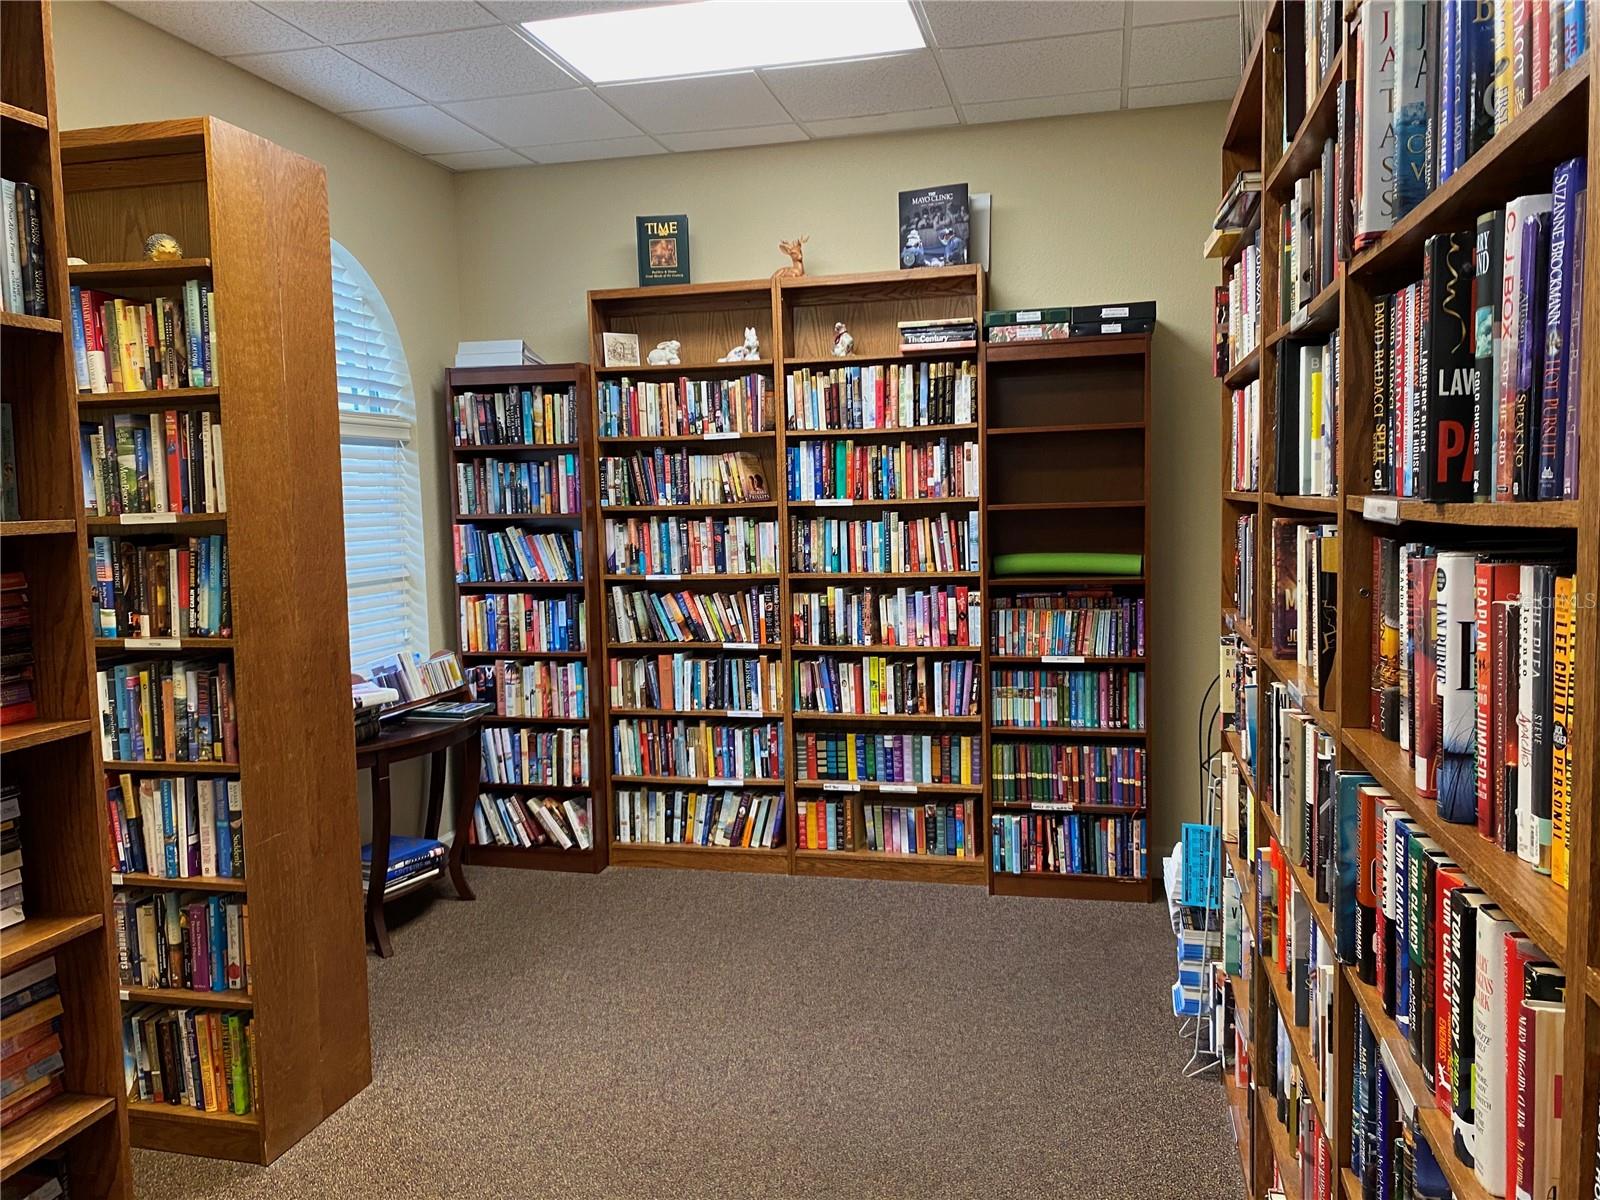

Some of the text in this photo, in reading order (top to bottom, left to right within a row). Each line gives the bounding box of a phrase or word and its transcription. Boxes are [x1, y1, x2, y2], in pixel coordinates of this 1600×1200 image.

[645, 222, 678, 235] TIME
[912, 195, 930, 205] MAYO
[930, 193, 954, 203] CLINIC
[1548, 174, 1569, 326] SUZANNE BROCKMANN
[82, 294, 92, 323] PRIMARY
[84, 324, 94, 351] COLORS
[1503, 276, 1515, 342] BOX
[1374, 302, 1387, 465] DAVID BALDACCI SPLIT
[1414, 392, 1420, 407] NO
[1420, 350, 1428, 412] LAWRENCE
[1499, 360, 1509, 466] OFF THE GRID
[1542, 360, 1561, 460] HOT PURSUIT
[1515, 394, 1527, 468] SPEAK NO
[121, 484, 129, 506] BINCHY
[1436, 634, 1447, 684] BURKE
[1477, 586, 1488, 779] CAPLAN JUMPED
[1532, 594, 1543, 746] THE PLEA STEVE
[1553, 621, 1568, 841] LEE CHILD PERSONAL
[233, 834, 243, 867] Suddenly
[1396, 834, 1405, 870] TOM
[1395, 872, 1404, 940] CLANCY
[1410, 857, 1419, 956] TOM CLANCY
[1452, 911, 1462, 959] TOM
[118, 914, 129, 970] BALTIMORE BOYS
[1443, 887, 1452, 1004] TOM CLANCY
[1451, 961, 1461, 1049] CLANCY
[1438, 1016, 1447, 1062] ENEMIES
[1453, 1088, 1459, 1107] OR
[1517, 1014, 1528, 1130] MARY HIGGINS CLARK
